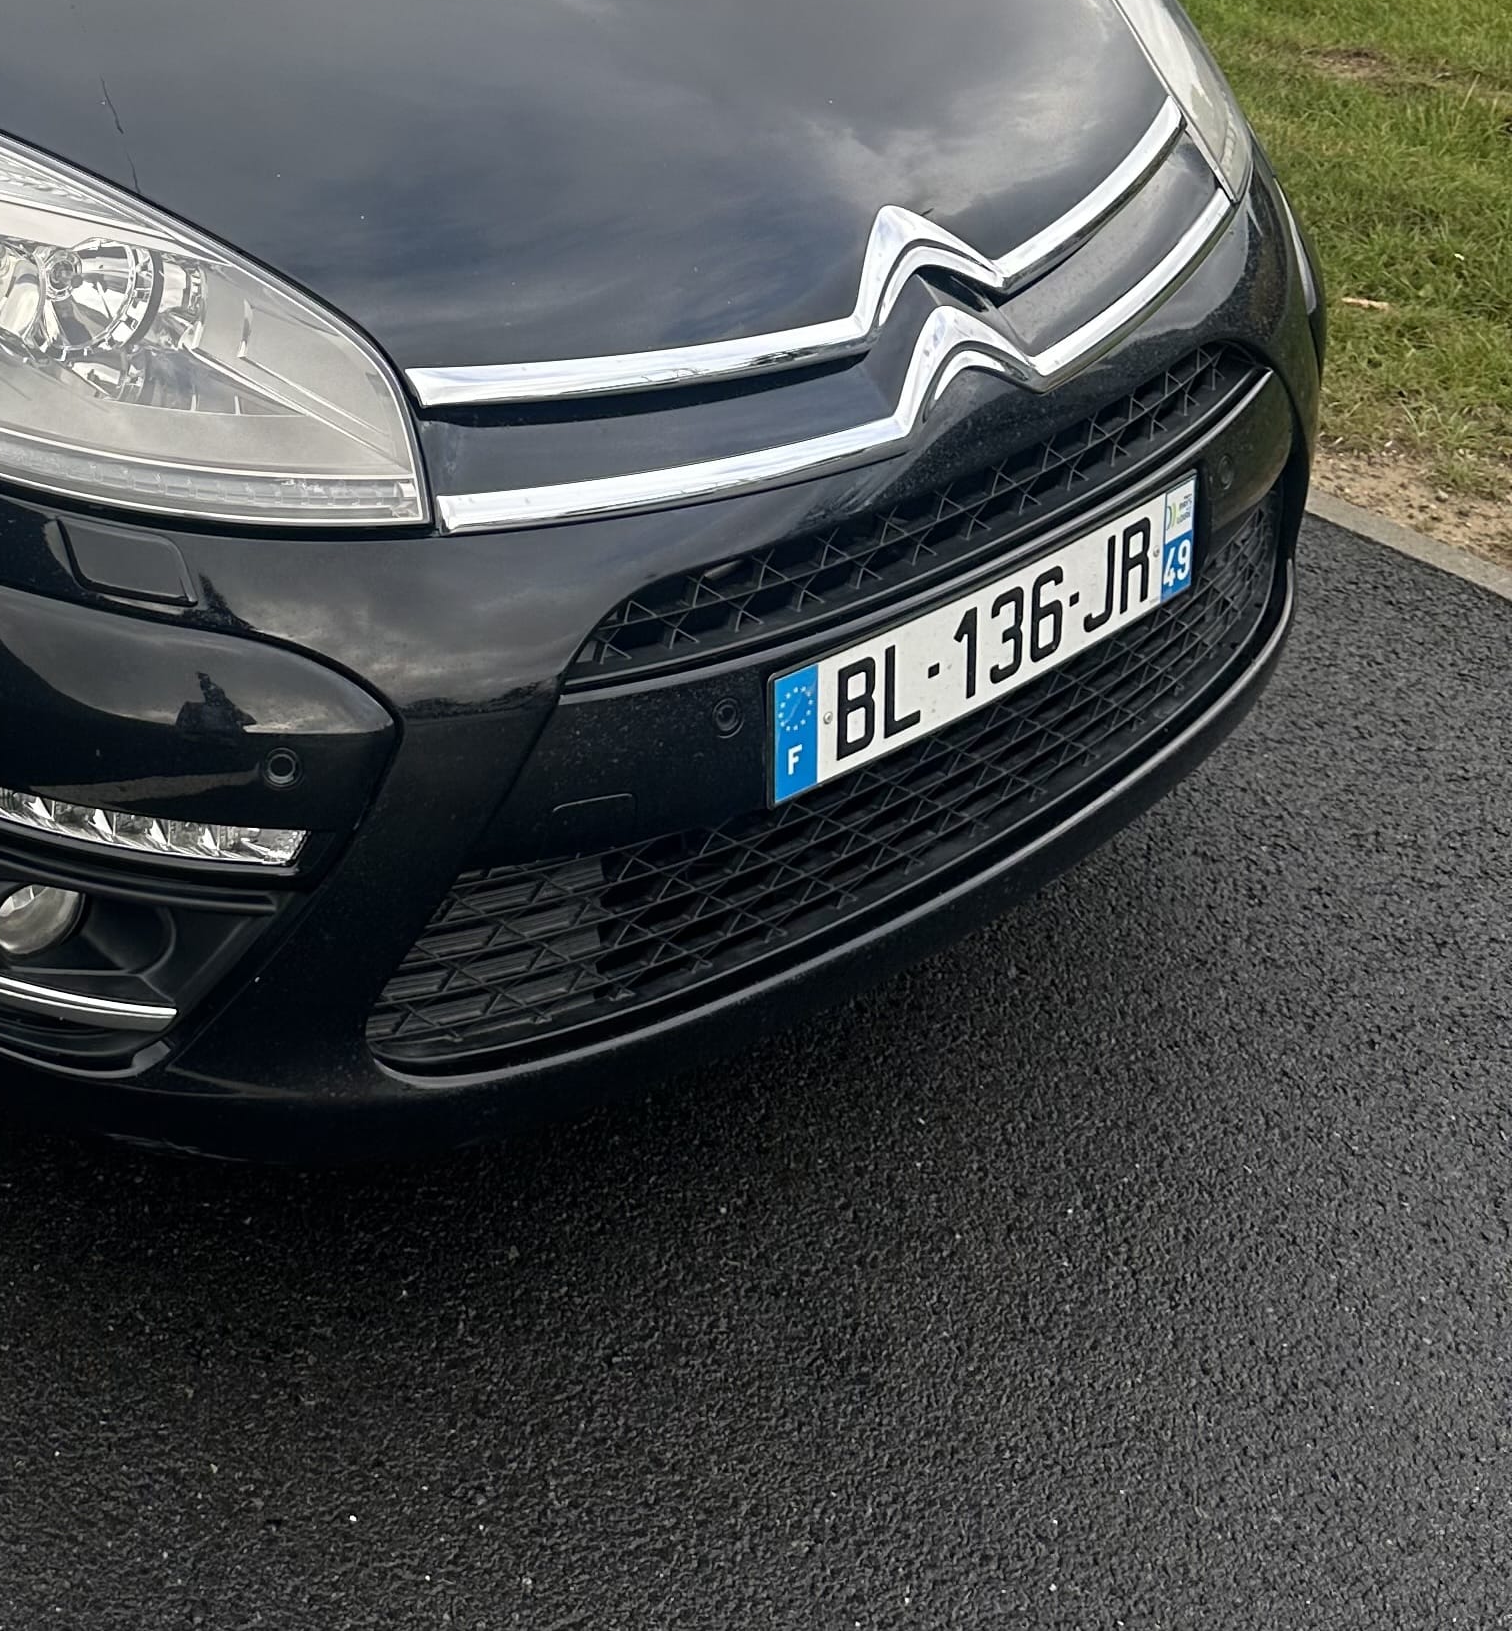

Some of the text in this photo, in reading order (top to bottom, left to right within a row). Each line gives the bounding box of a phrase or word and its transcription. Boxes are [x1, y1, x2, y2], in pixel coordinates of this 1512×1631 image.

[1163, 538, 1191, 588] 49
[835, 516, 1152, 761] BL-136-JR
[787, 744, 803, 775] F
